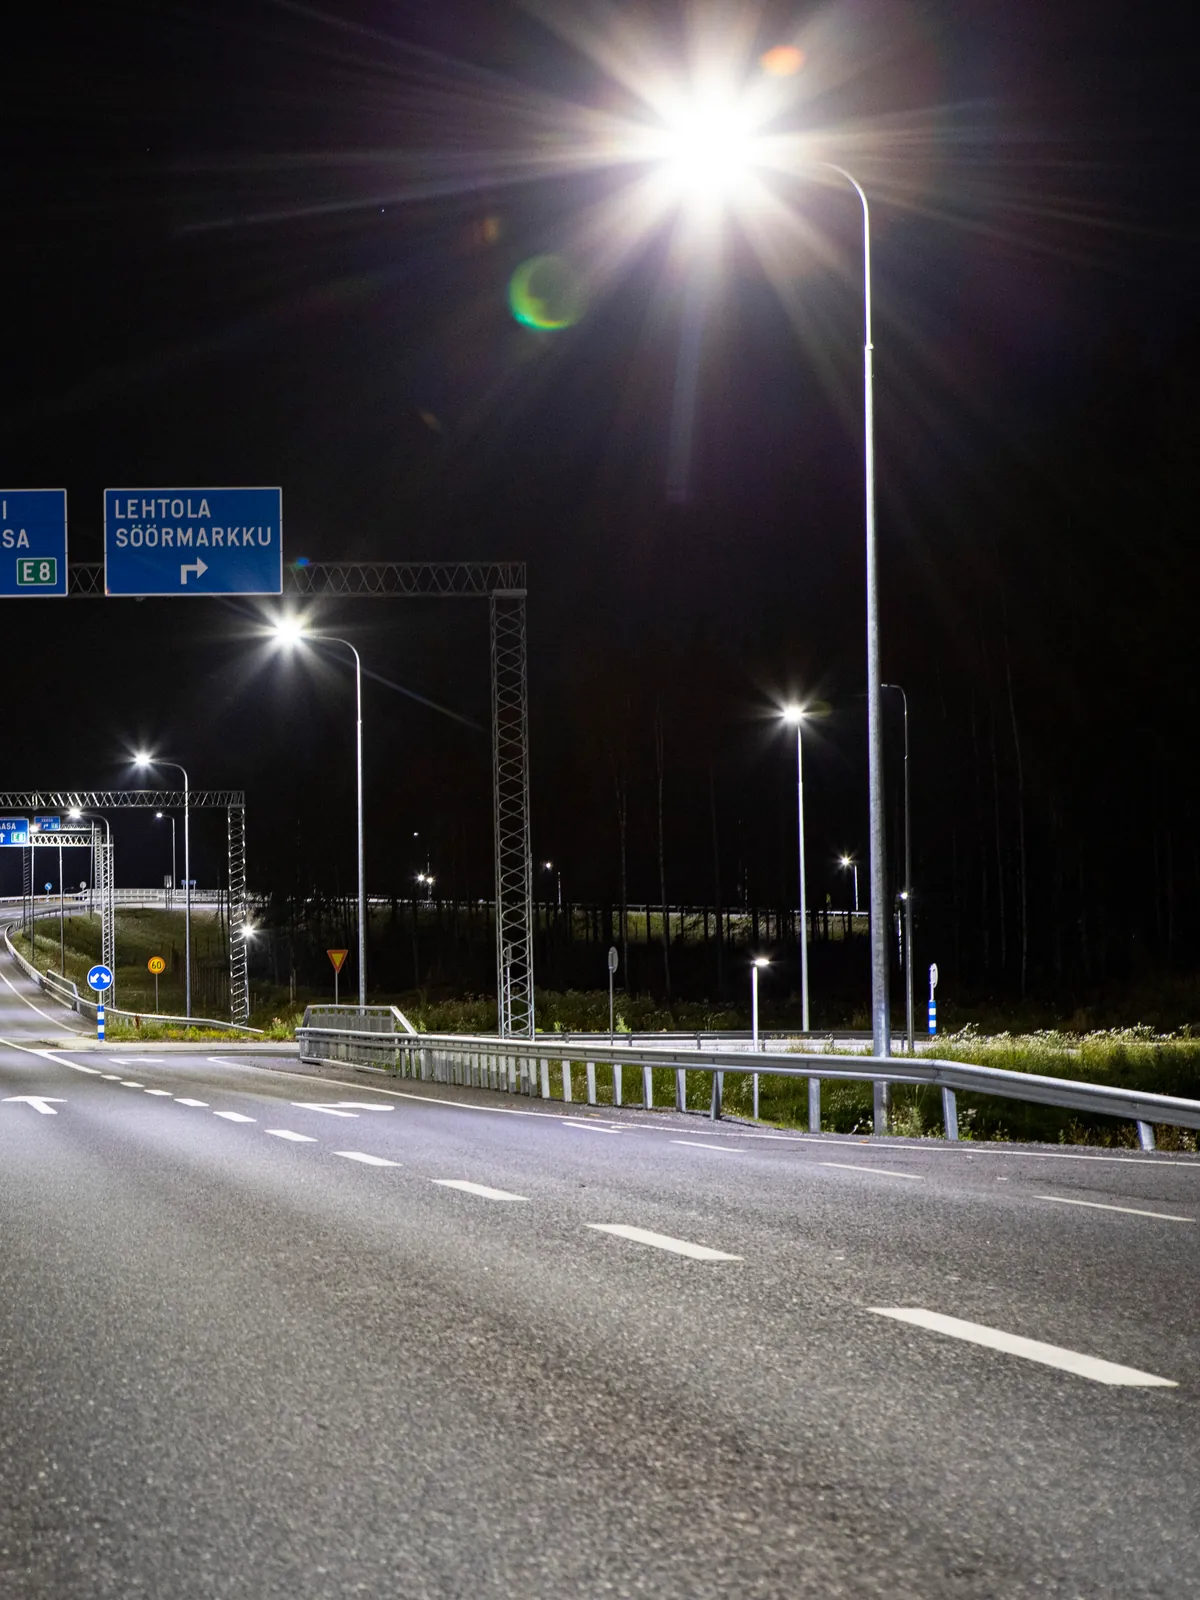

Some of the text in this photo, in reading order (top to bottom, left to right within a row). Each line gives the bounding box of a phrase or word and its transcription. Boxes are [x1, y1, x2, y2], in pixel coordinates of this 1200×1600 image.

[115, 498, 212, 519] LEHTOLA
[115, 523, 272, 547] SÖÖRMARKKU
[23, 562, 51, 582] E8
[152, 961, 162, 969] 60
